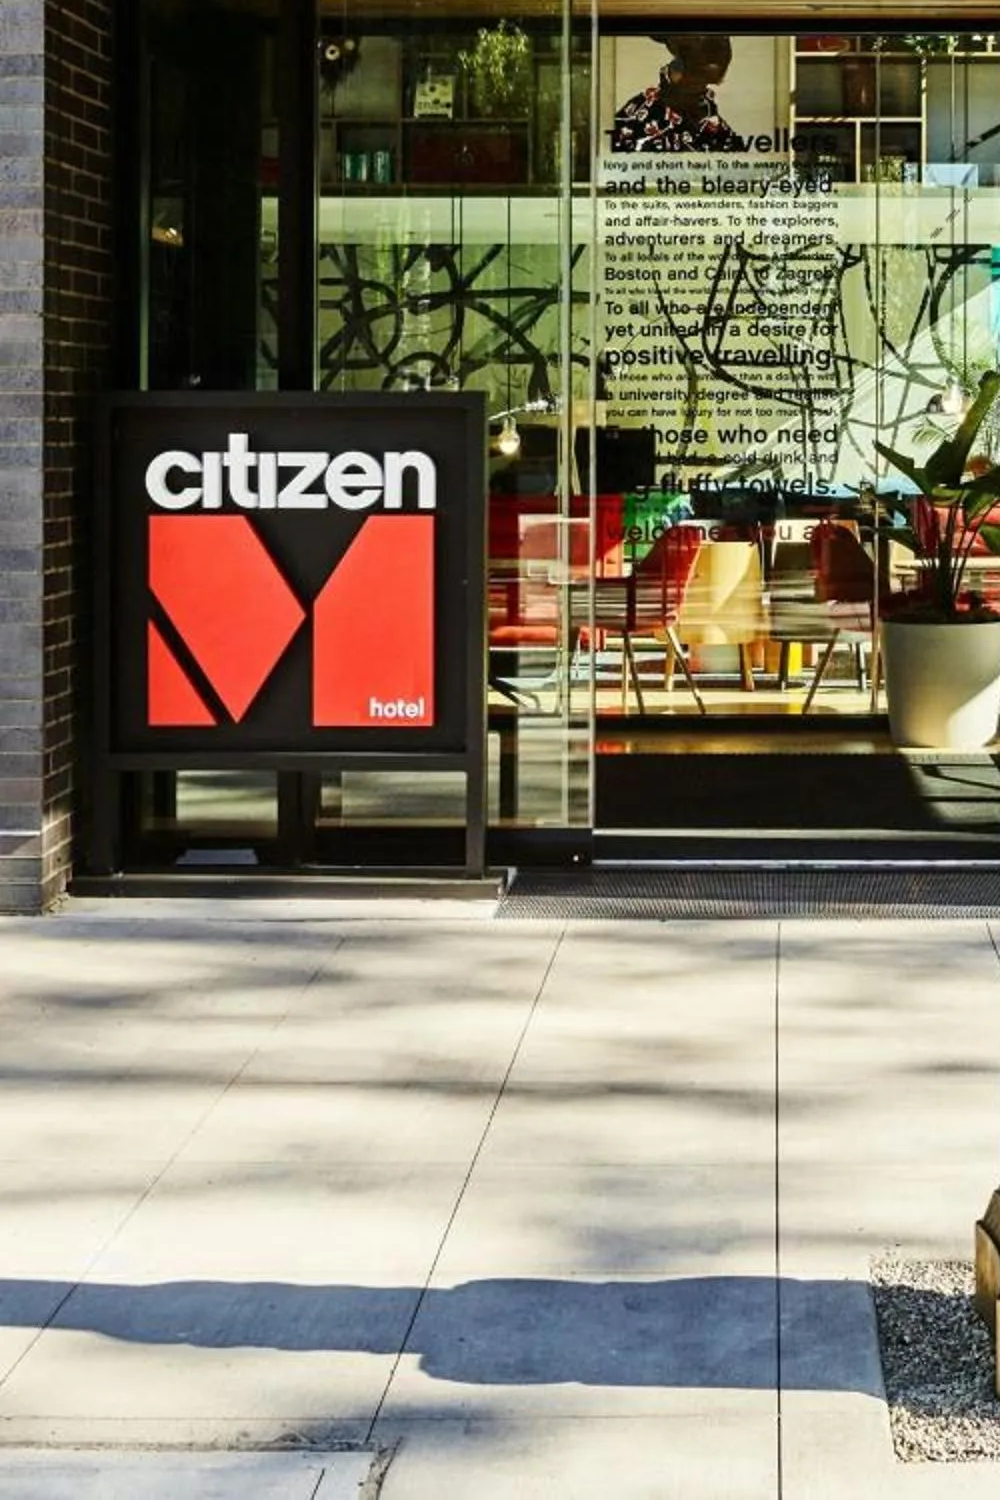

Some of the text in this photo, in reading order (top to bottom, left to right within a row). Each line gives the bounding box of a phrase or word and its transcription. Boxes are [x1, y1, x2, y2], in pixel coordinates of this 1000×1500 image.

[603, 160, 628, 172] long
[631, 160, 652, 170] and
[655, 160, 683, 170] short
[717, 160, 729, 169] To
[731, 160, 749, 169] the
[605, 176, 839, 199] and the bleary-eyed.
[605, 200, 839, 213] To the suits, weekenders, fashion baggers
[605, 215, 839, 229] and affair-havers. To the explorers,
[605, 231, 839, 245] adventurers and dreamers.
[605, 252, 617, 261] To
[621, 252, 634, 261] all
[673, 252, 685, 261] of
[688, 252, 705, 261] the
[605, 267, 661, 281] Boston
[667, 266, 699, 281] and
[605, 301, 623, 315] To
[629, 300, 649, 315] all
[655, 300, 689, 315] who
[730, 300, 839, 319] ndependent
[605, 323, 634, 342] yet
[640, 321, 700, 337] united
[729, 325, 741, 337] a
[747, 320, 807, 337] desire
[605, 345, 704, 372] positive
[652, 372, 673, 381] who
[620, 388, 688, 404] university
[696, 388, 749, 404] degree
[605, 409, 625, 418] you
[627, 409, 649, 417] can
[651, 407, 677, 417] have
[716, 407, 731, 417] for
[735, 408, 753, 417] not
[756, 407, 774, 417] too
[717, 423, 768, 444] who
[777, 423, 838, 444] need
[808, 449, 838, 464] and
[145, 432, 437, 510] citizen
[738, 472, 838, 496] towels.
[369, 697, 425, 718] hotel
